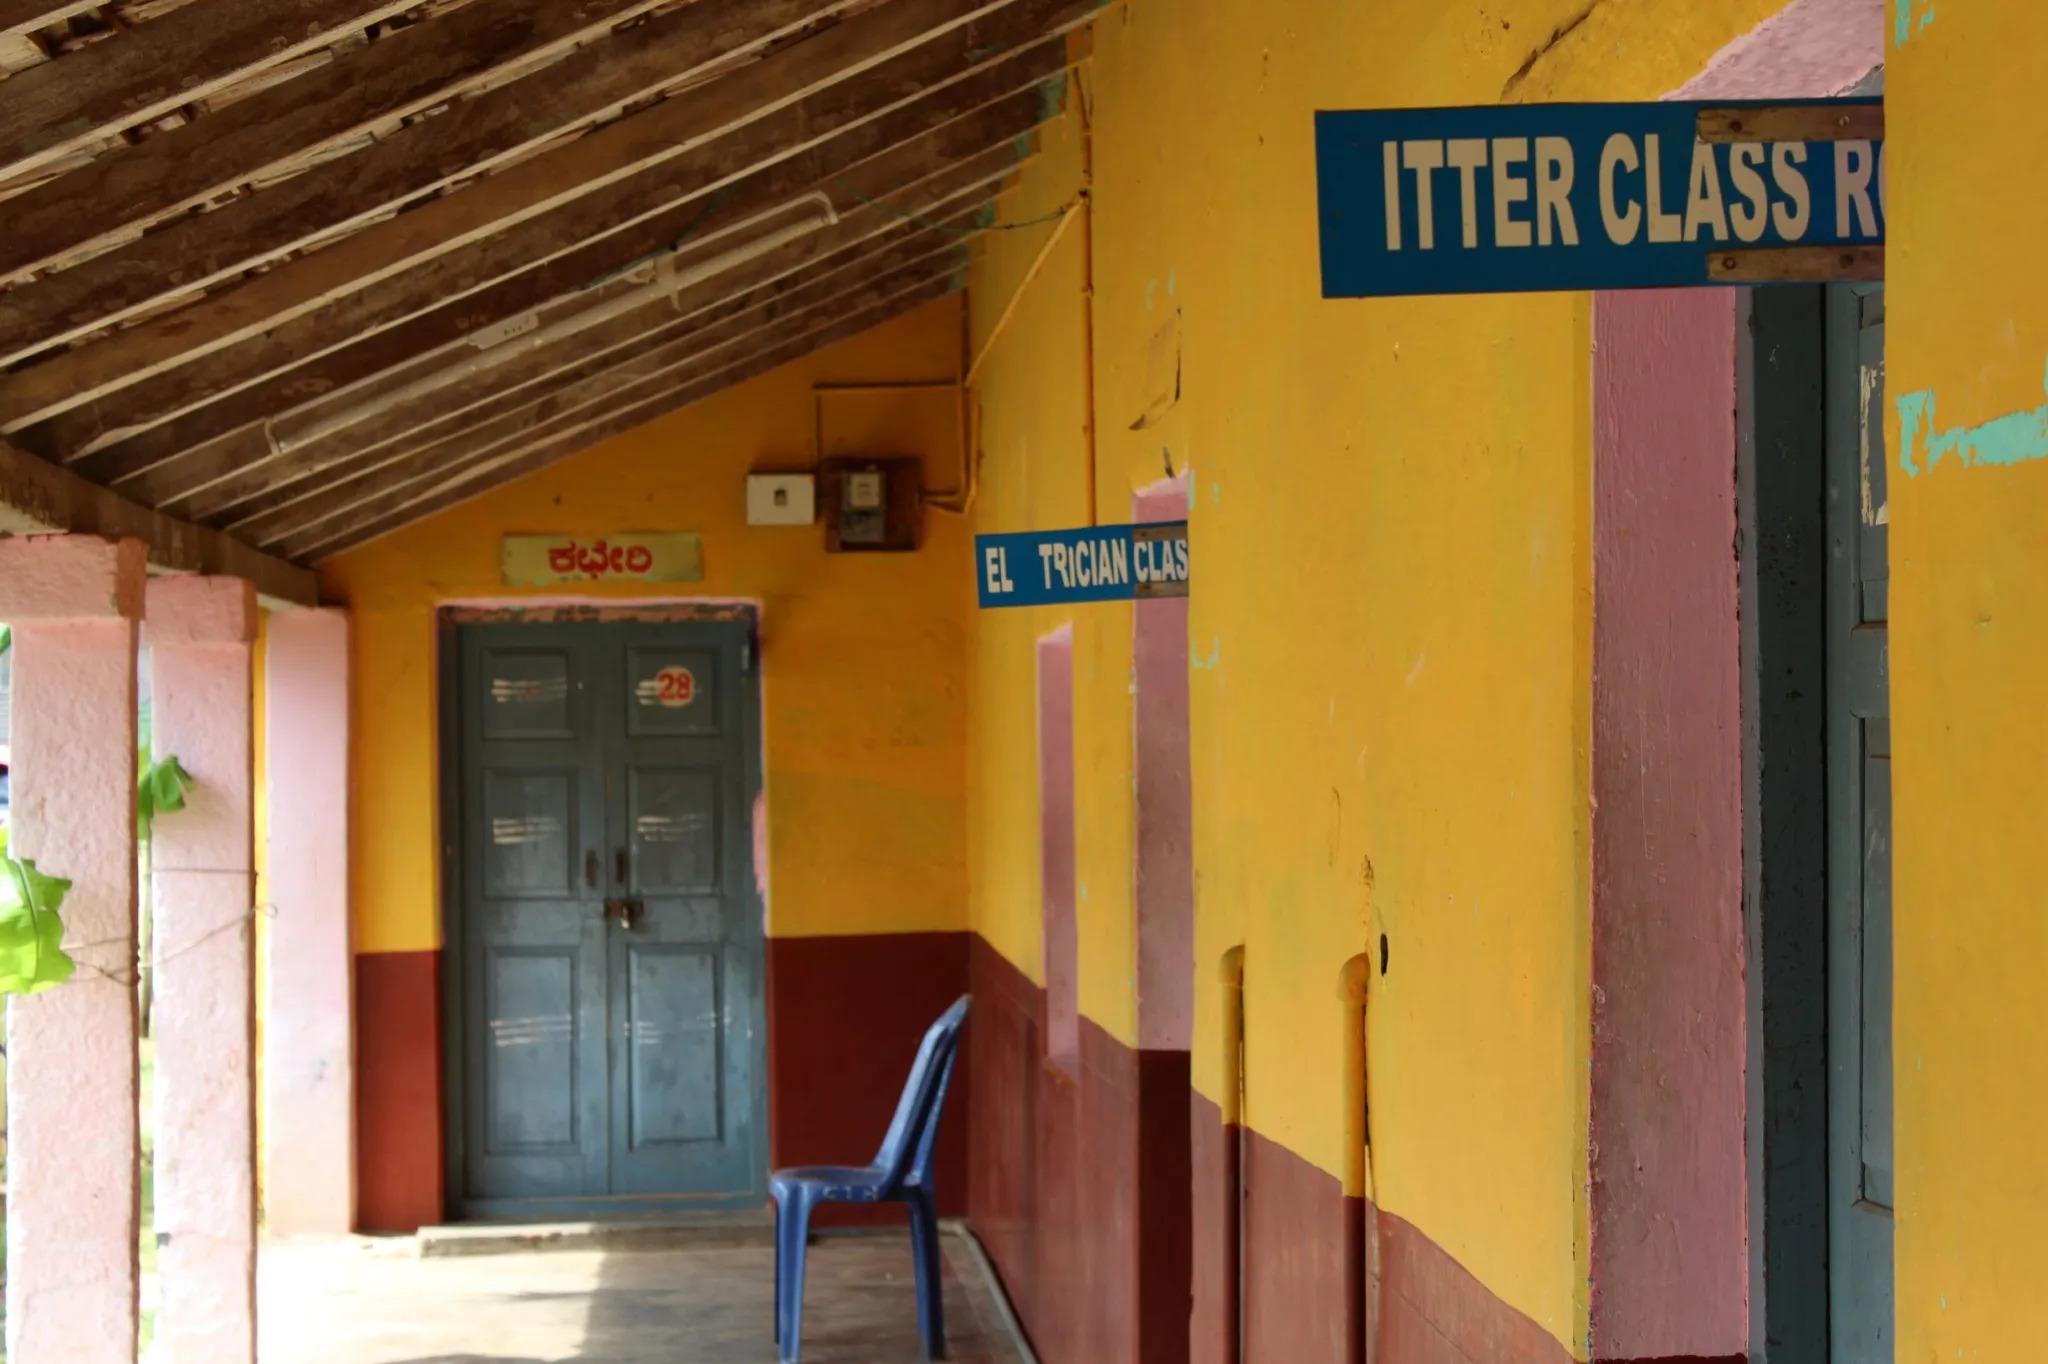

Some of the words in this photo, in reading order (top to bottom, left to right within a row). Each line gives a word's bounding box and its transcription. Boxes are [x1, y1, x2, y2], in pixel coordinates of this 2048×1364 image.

[1383, 137, 1580, 250] ITTER
[1599, 133, 1811, 245] CLASS
[1834, 139, 1885, 238] R
[985, 547, 1014, 593] EL
[1038, 538, 1129, 589] TRICIAN
[656, 672, 693, 700] 28
